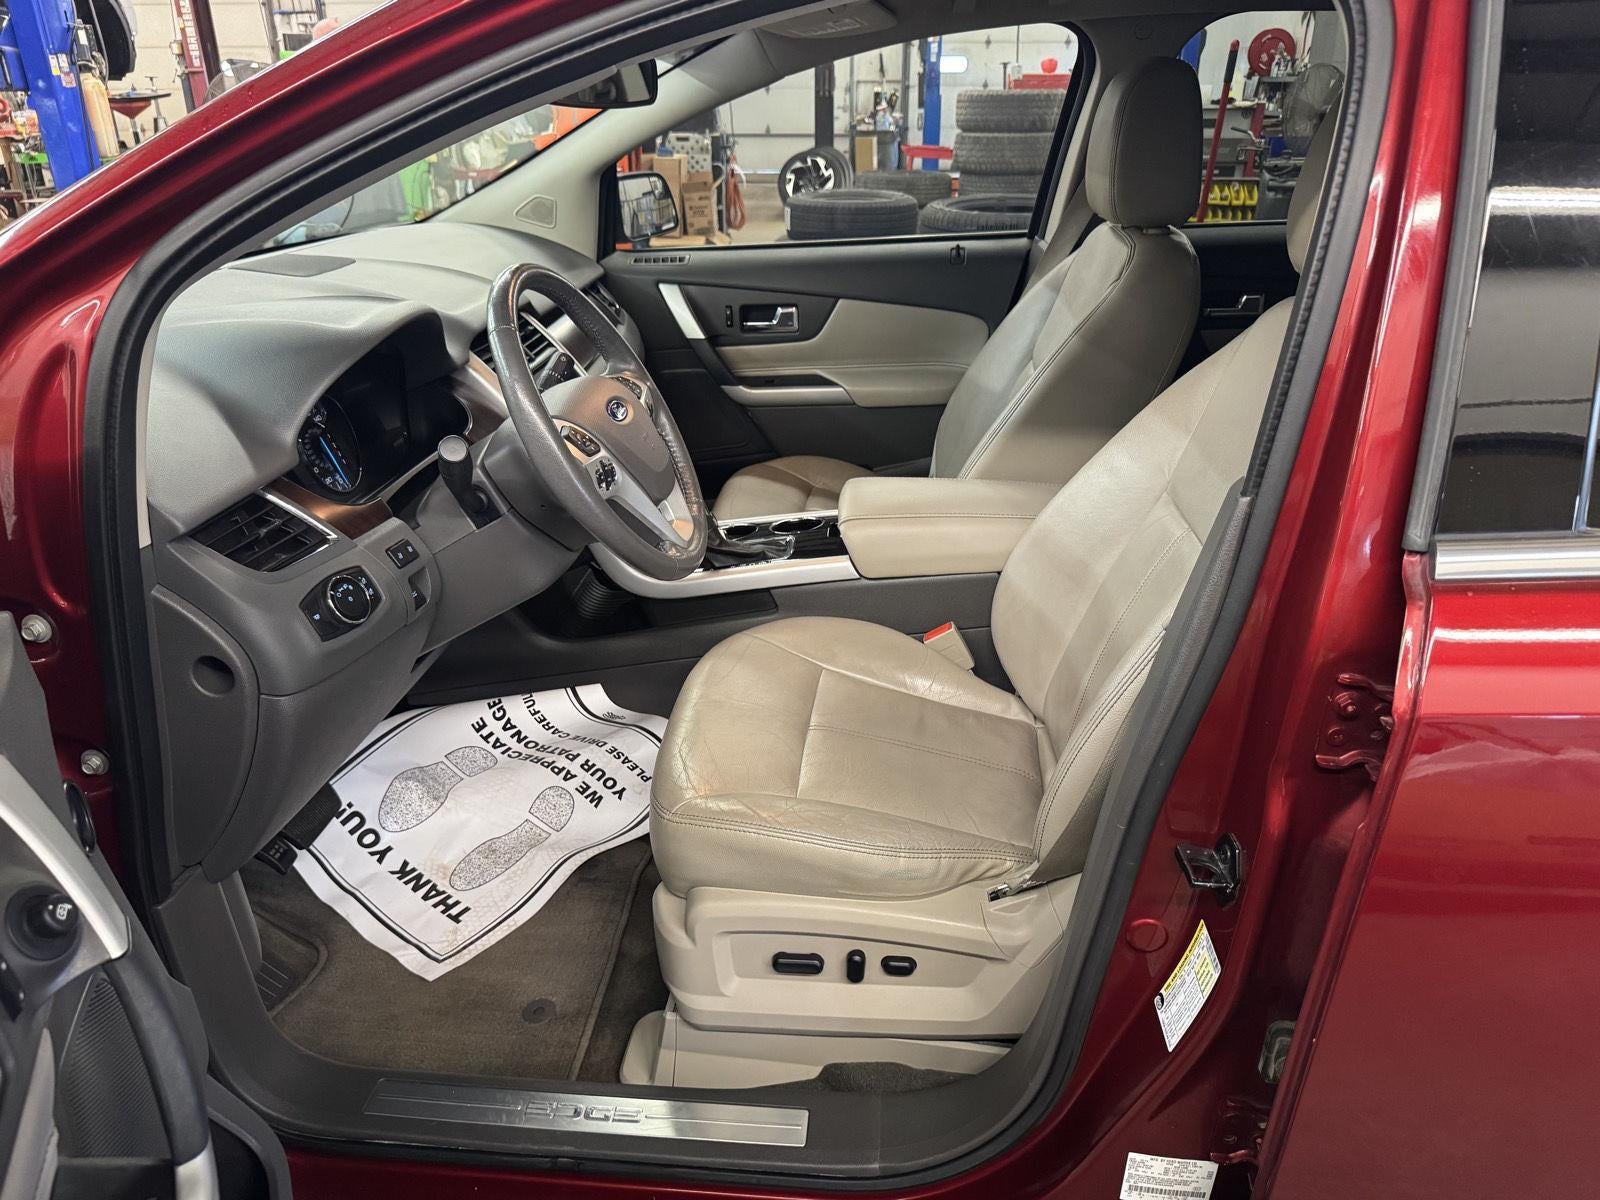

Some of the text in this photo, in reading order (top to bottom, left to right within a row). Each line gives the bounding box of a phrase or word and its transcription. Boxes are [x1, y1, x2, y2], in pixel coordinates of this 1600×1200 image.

[471, 716, 604, 809] WE APPRECIATE
[487, 697, 627, 801] YOUR PATRONAGE
[521, 692, 653, 783] PLEASE DRIVE CAREFUL
[334, 801, 472, 924] THANK YOU!
[525, 1099, 644, 1123] EDGE
